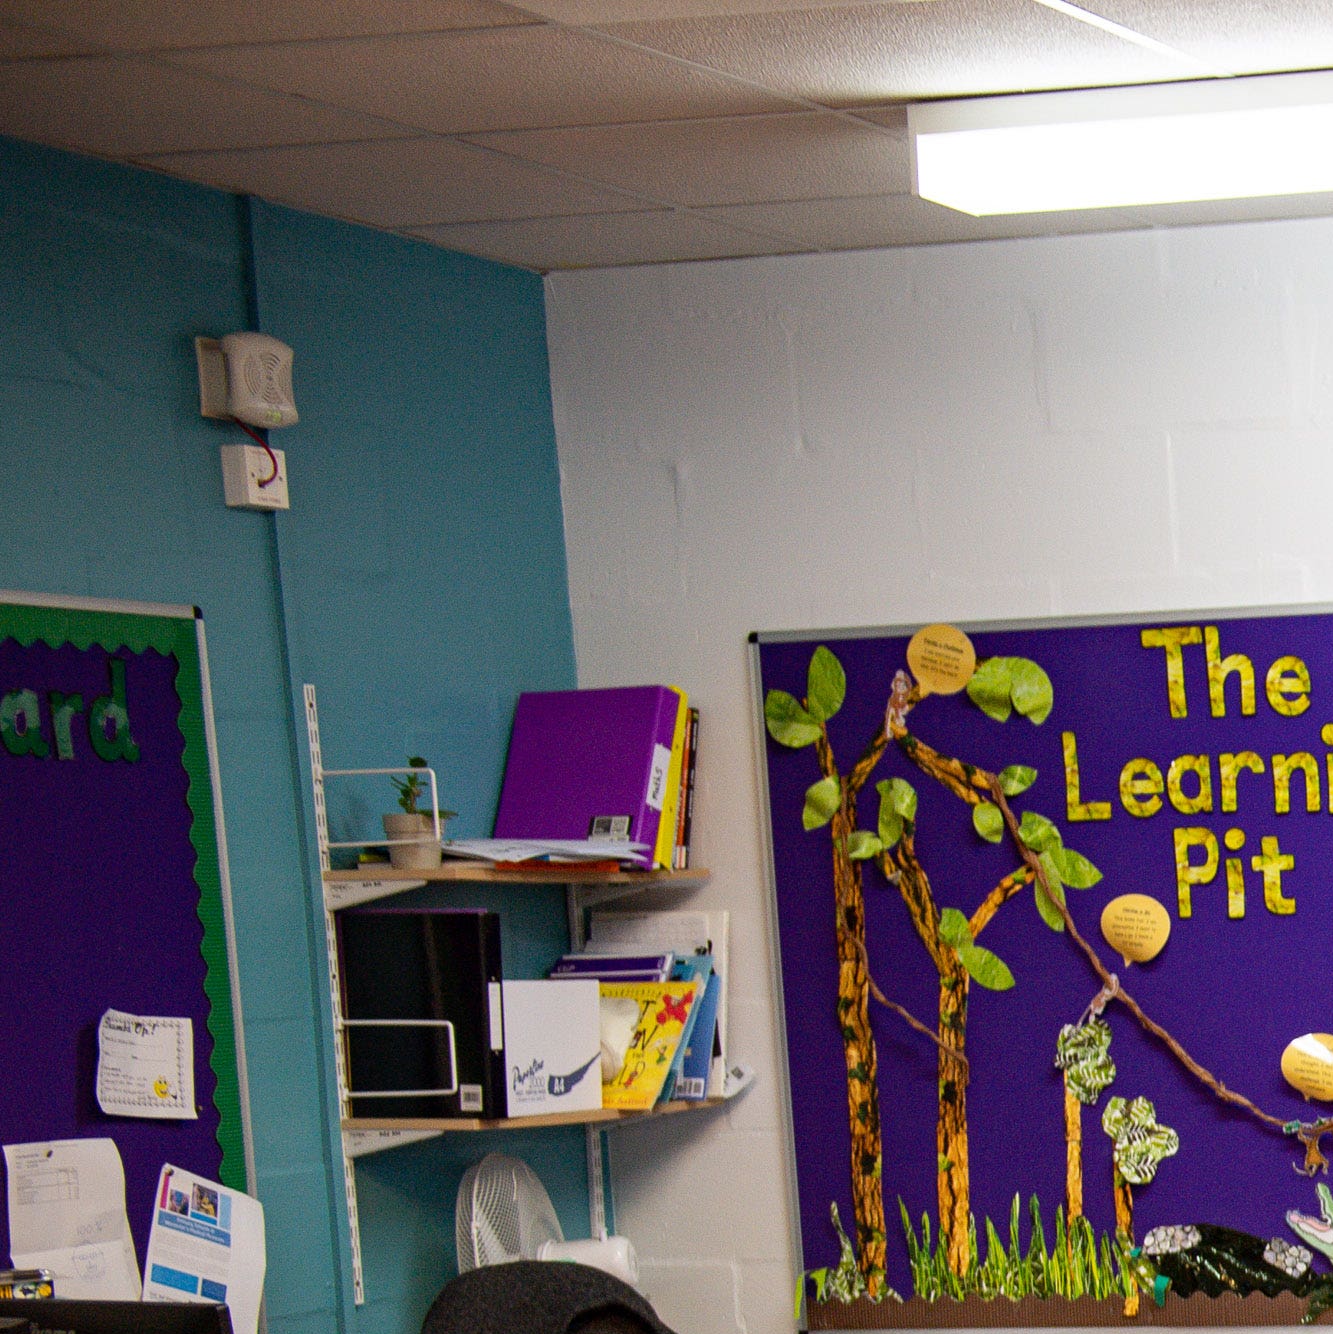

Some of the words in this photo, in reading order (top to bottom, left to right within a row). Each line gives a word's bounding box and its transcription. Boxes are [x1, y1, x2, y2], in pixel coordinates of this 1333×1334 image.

[1141, 625, 1312, 719] The
[1173, 826, 1297, 919] Pit
[554, 1077, 566, 1094] A4
